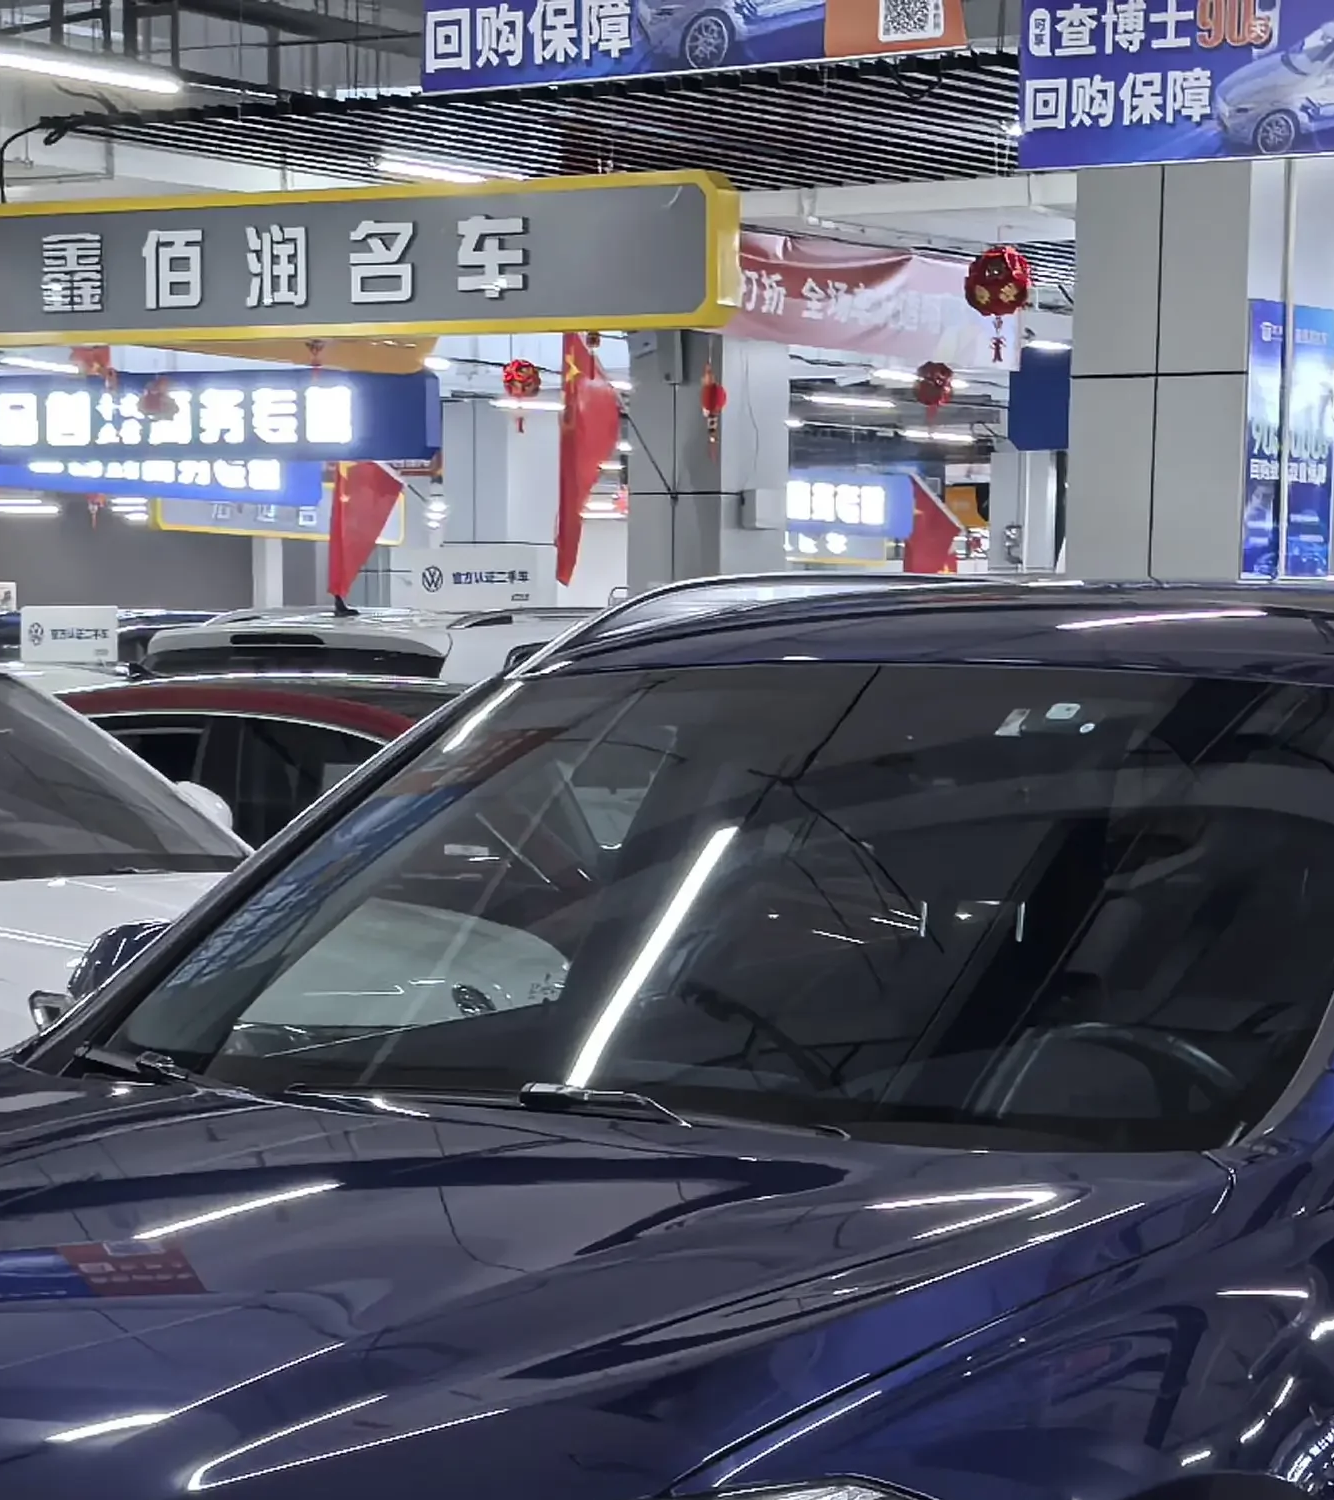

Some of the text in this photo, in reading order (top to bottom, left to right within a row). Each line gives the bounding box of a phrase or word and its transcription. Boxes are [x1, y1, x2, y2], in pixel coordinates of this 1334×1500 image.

[424, 0, 633, 74] 回购保障
[1024, 67, 1212, 131] 回购保障
[41, 214, 530, 315] 鑫佰润名车
